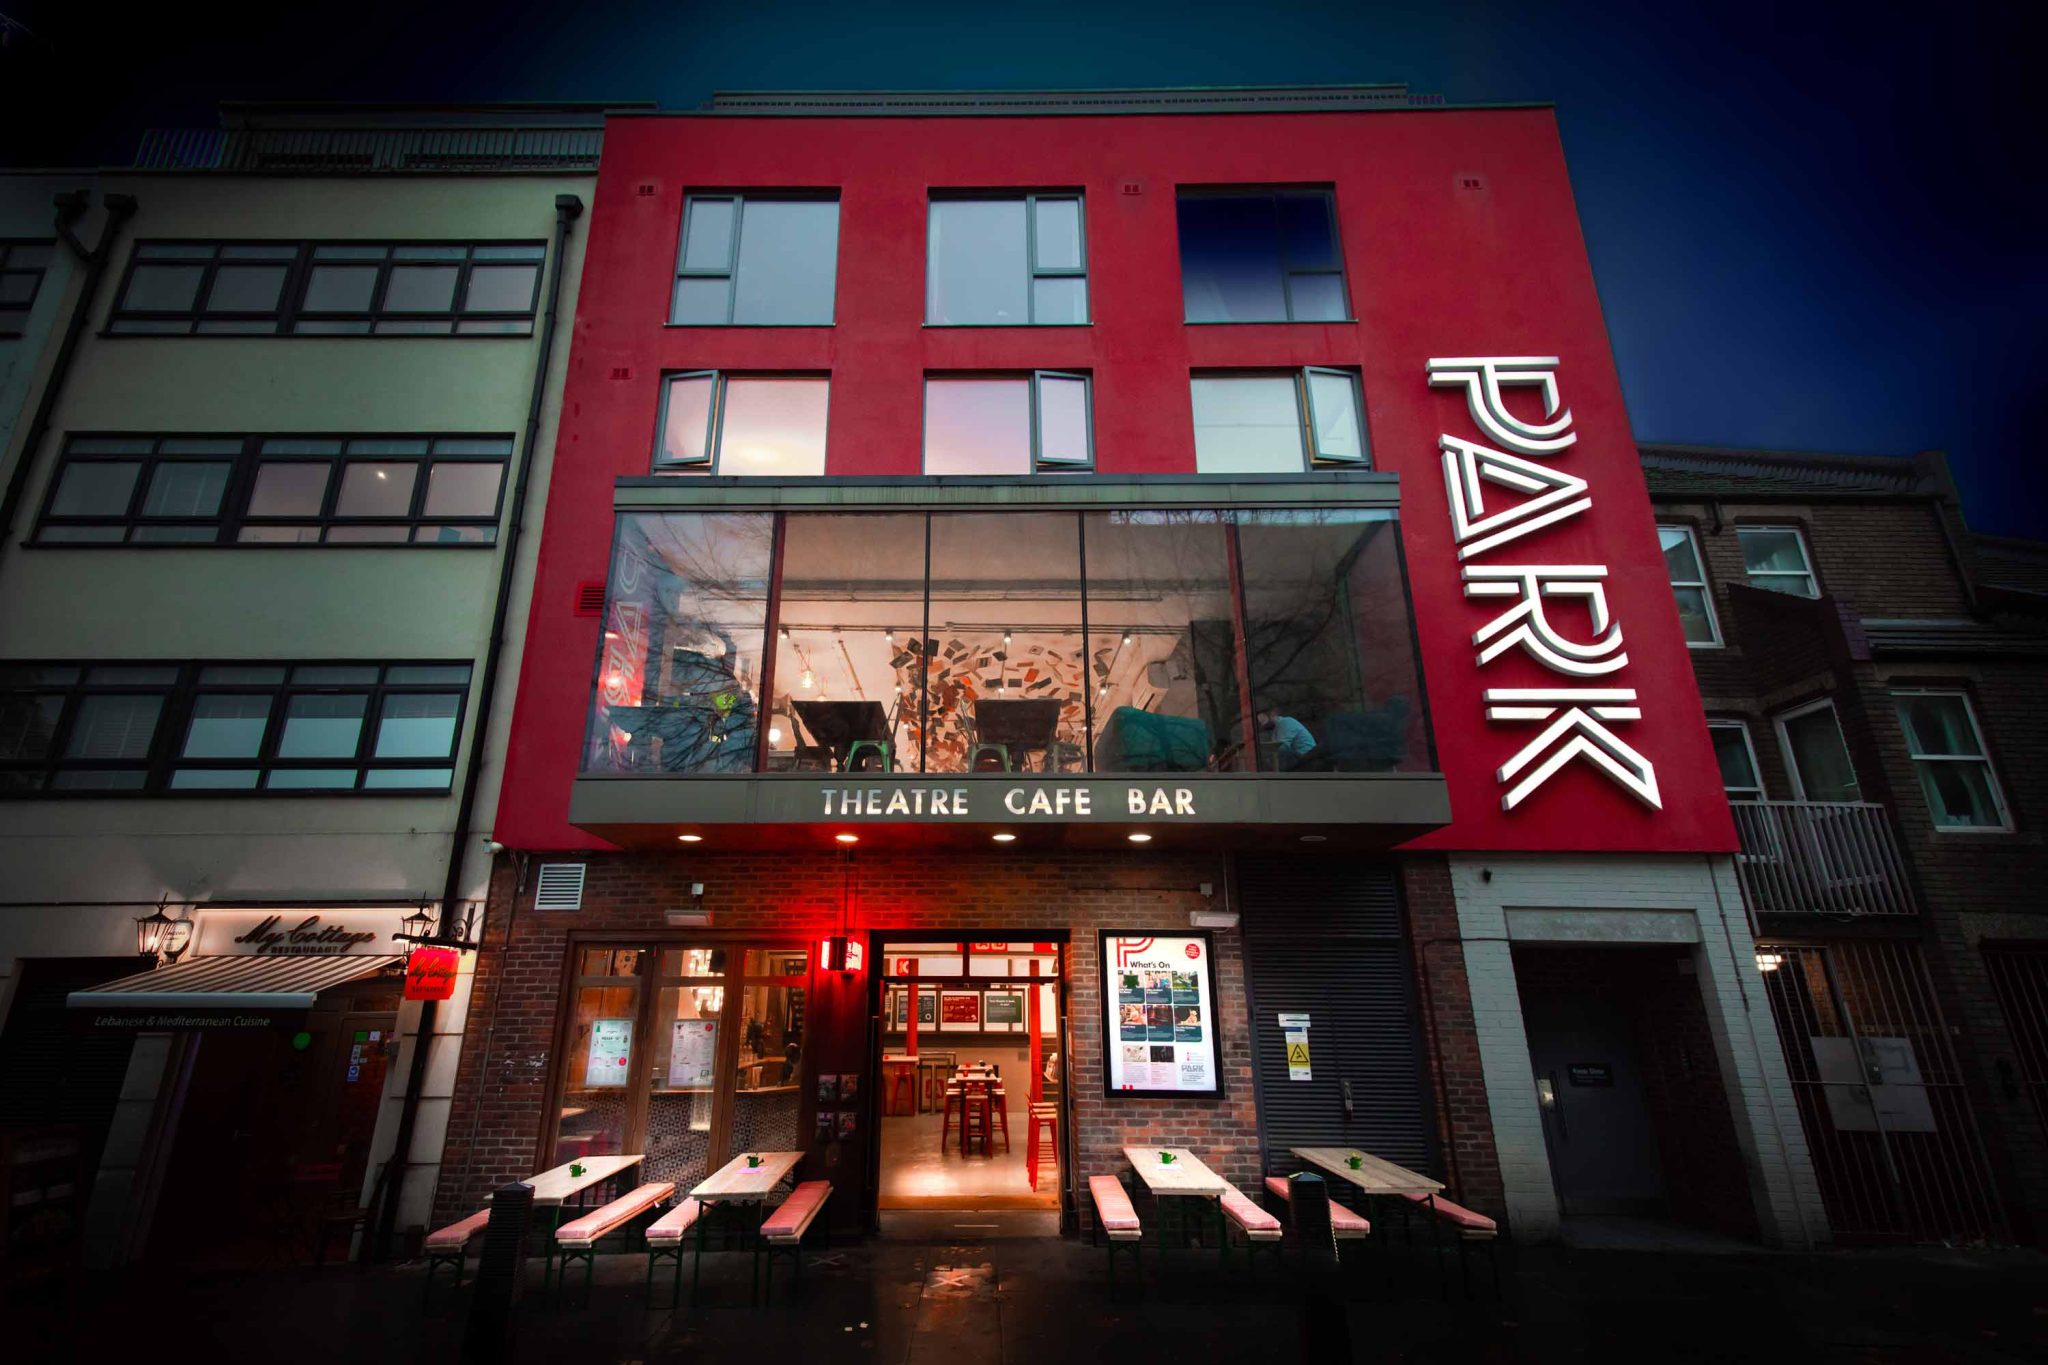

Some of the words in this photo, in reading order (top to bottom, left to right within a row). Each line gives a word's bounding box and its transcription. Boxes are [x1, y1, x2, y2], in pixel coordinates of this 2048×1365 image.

[1425, 356, 1664, 811] PARK
[822, 788, 969, 815] THEATRE
[1004, 788, 1091, 815] CAFE
[1128, 788, 1196, 815] BAR
[235, 915, 284, 954] My
[287, 915, 376, 953] Cottage
[1130, 961, 1157, 969] What's
[1158, 961, 1171, 969] On
[95, 1015, 146, 1027] Lebanese
[157, 1015, 232, 1027] Mediterranean
[233, 1015, 270, 1027] Cuisine
